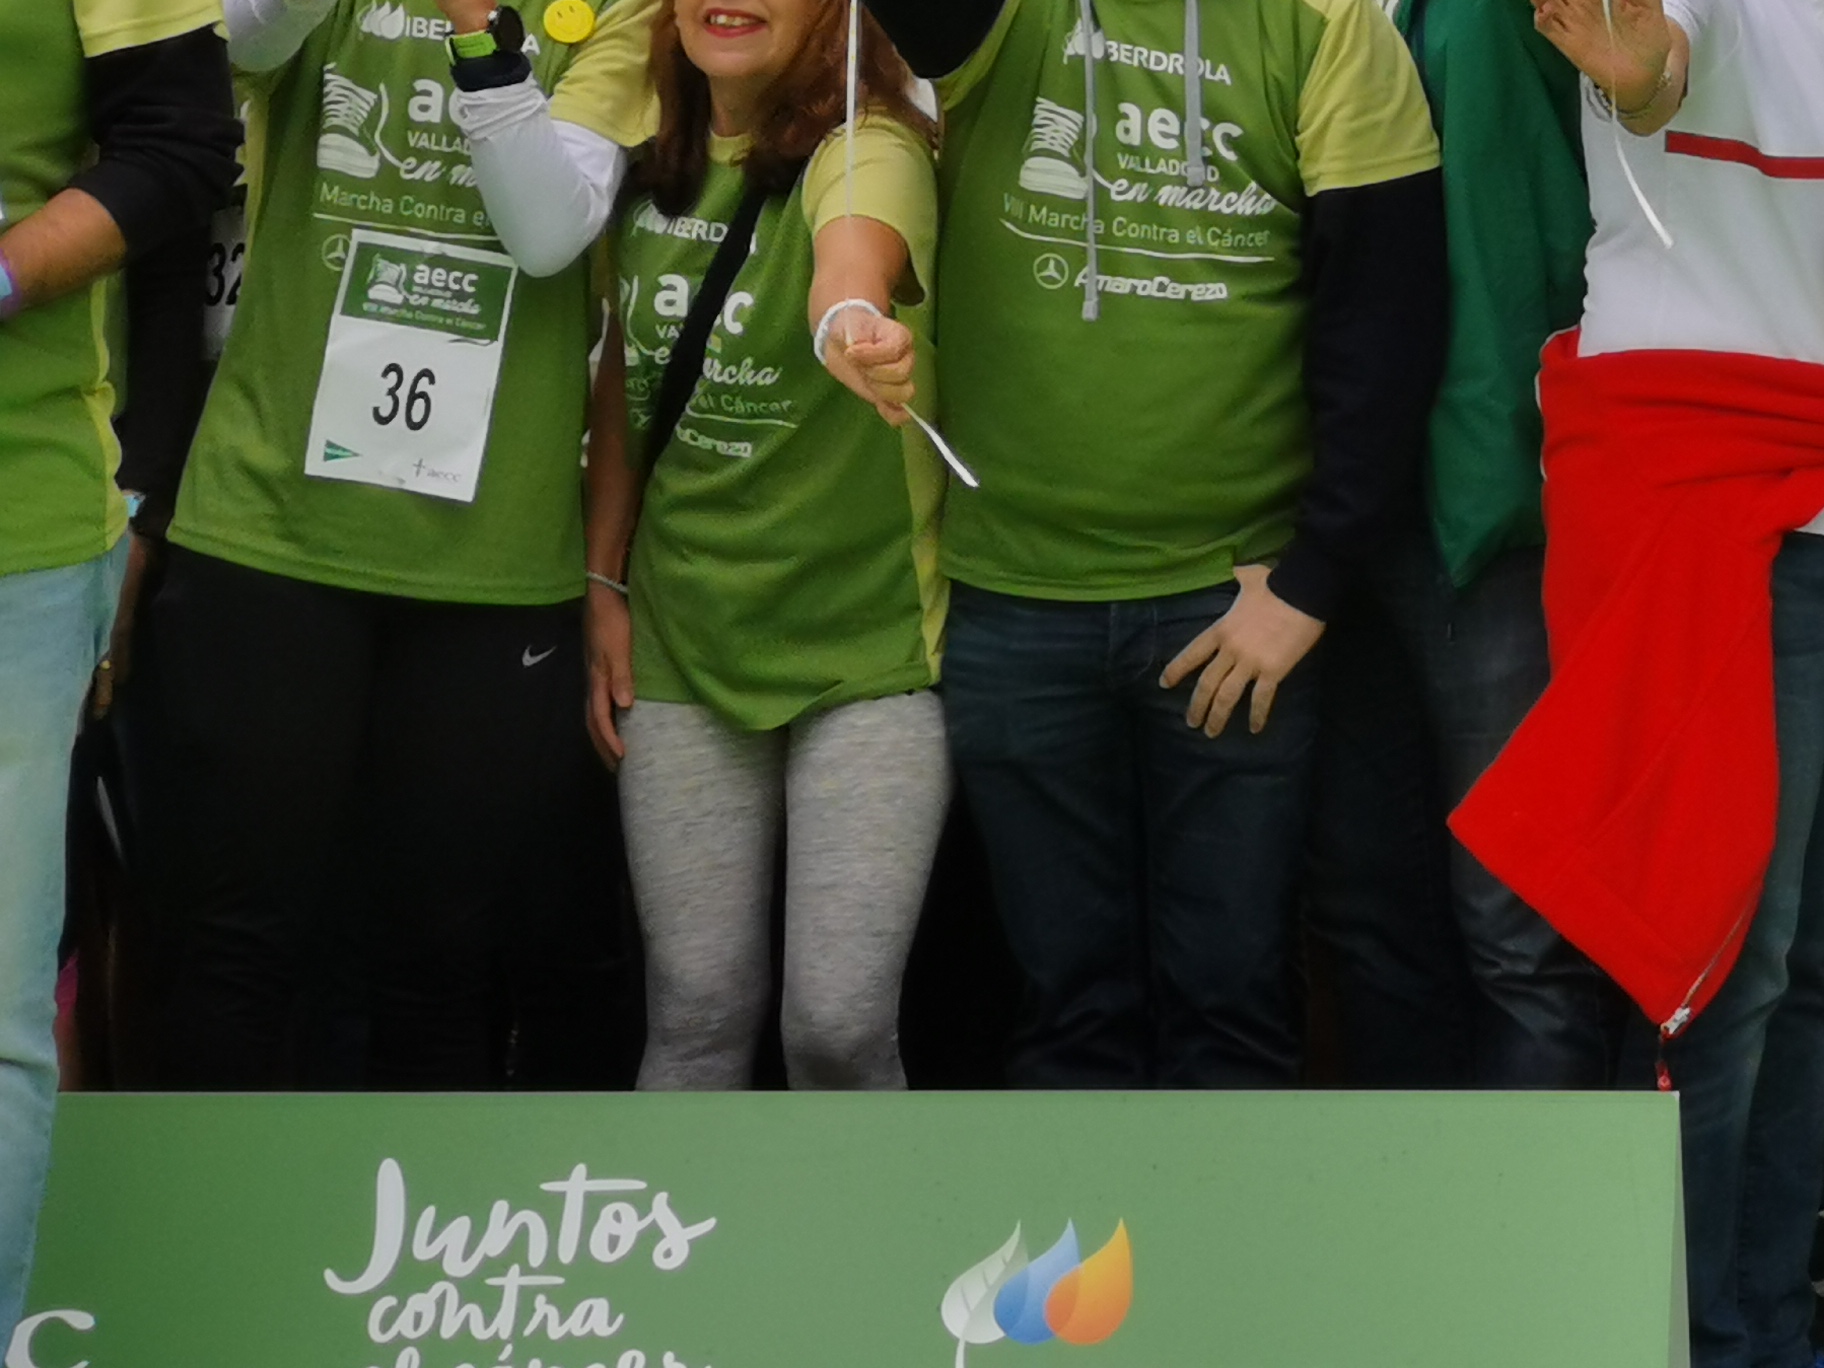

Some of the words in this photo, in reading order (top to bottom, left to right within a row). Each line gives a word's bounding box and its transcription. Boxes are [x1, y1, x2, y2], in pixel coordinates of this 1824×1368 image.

[1105, 40, 1232, 86] BERDRLA
[401, 156, 445, 182] en
[1117, 152, 1220, 182] VALLADOD
[319, 182, 394, 214] Marcha
[399, 194, 466, 225] Contra
[1109, 178, 1148, 202] en
[1112, 216, 1180, 244] Contra
[1186, 224, 1204, 245] el
[1206, 226, 1270, 248] Cáncer
[412, 263, 480, 293] aecc
[654, 273, 754, 334] ac
[372, 362, 437, 431] 36
[323, 1157, 718, 1295] Juntos
[367, 1263, 625, 1343] contra
